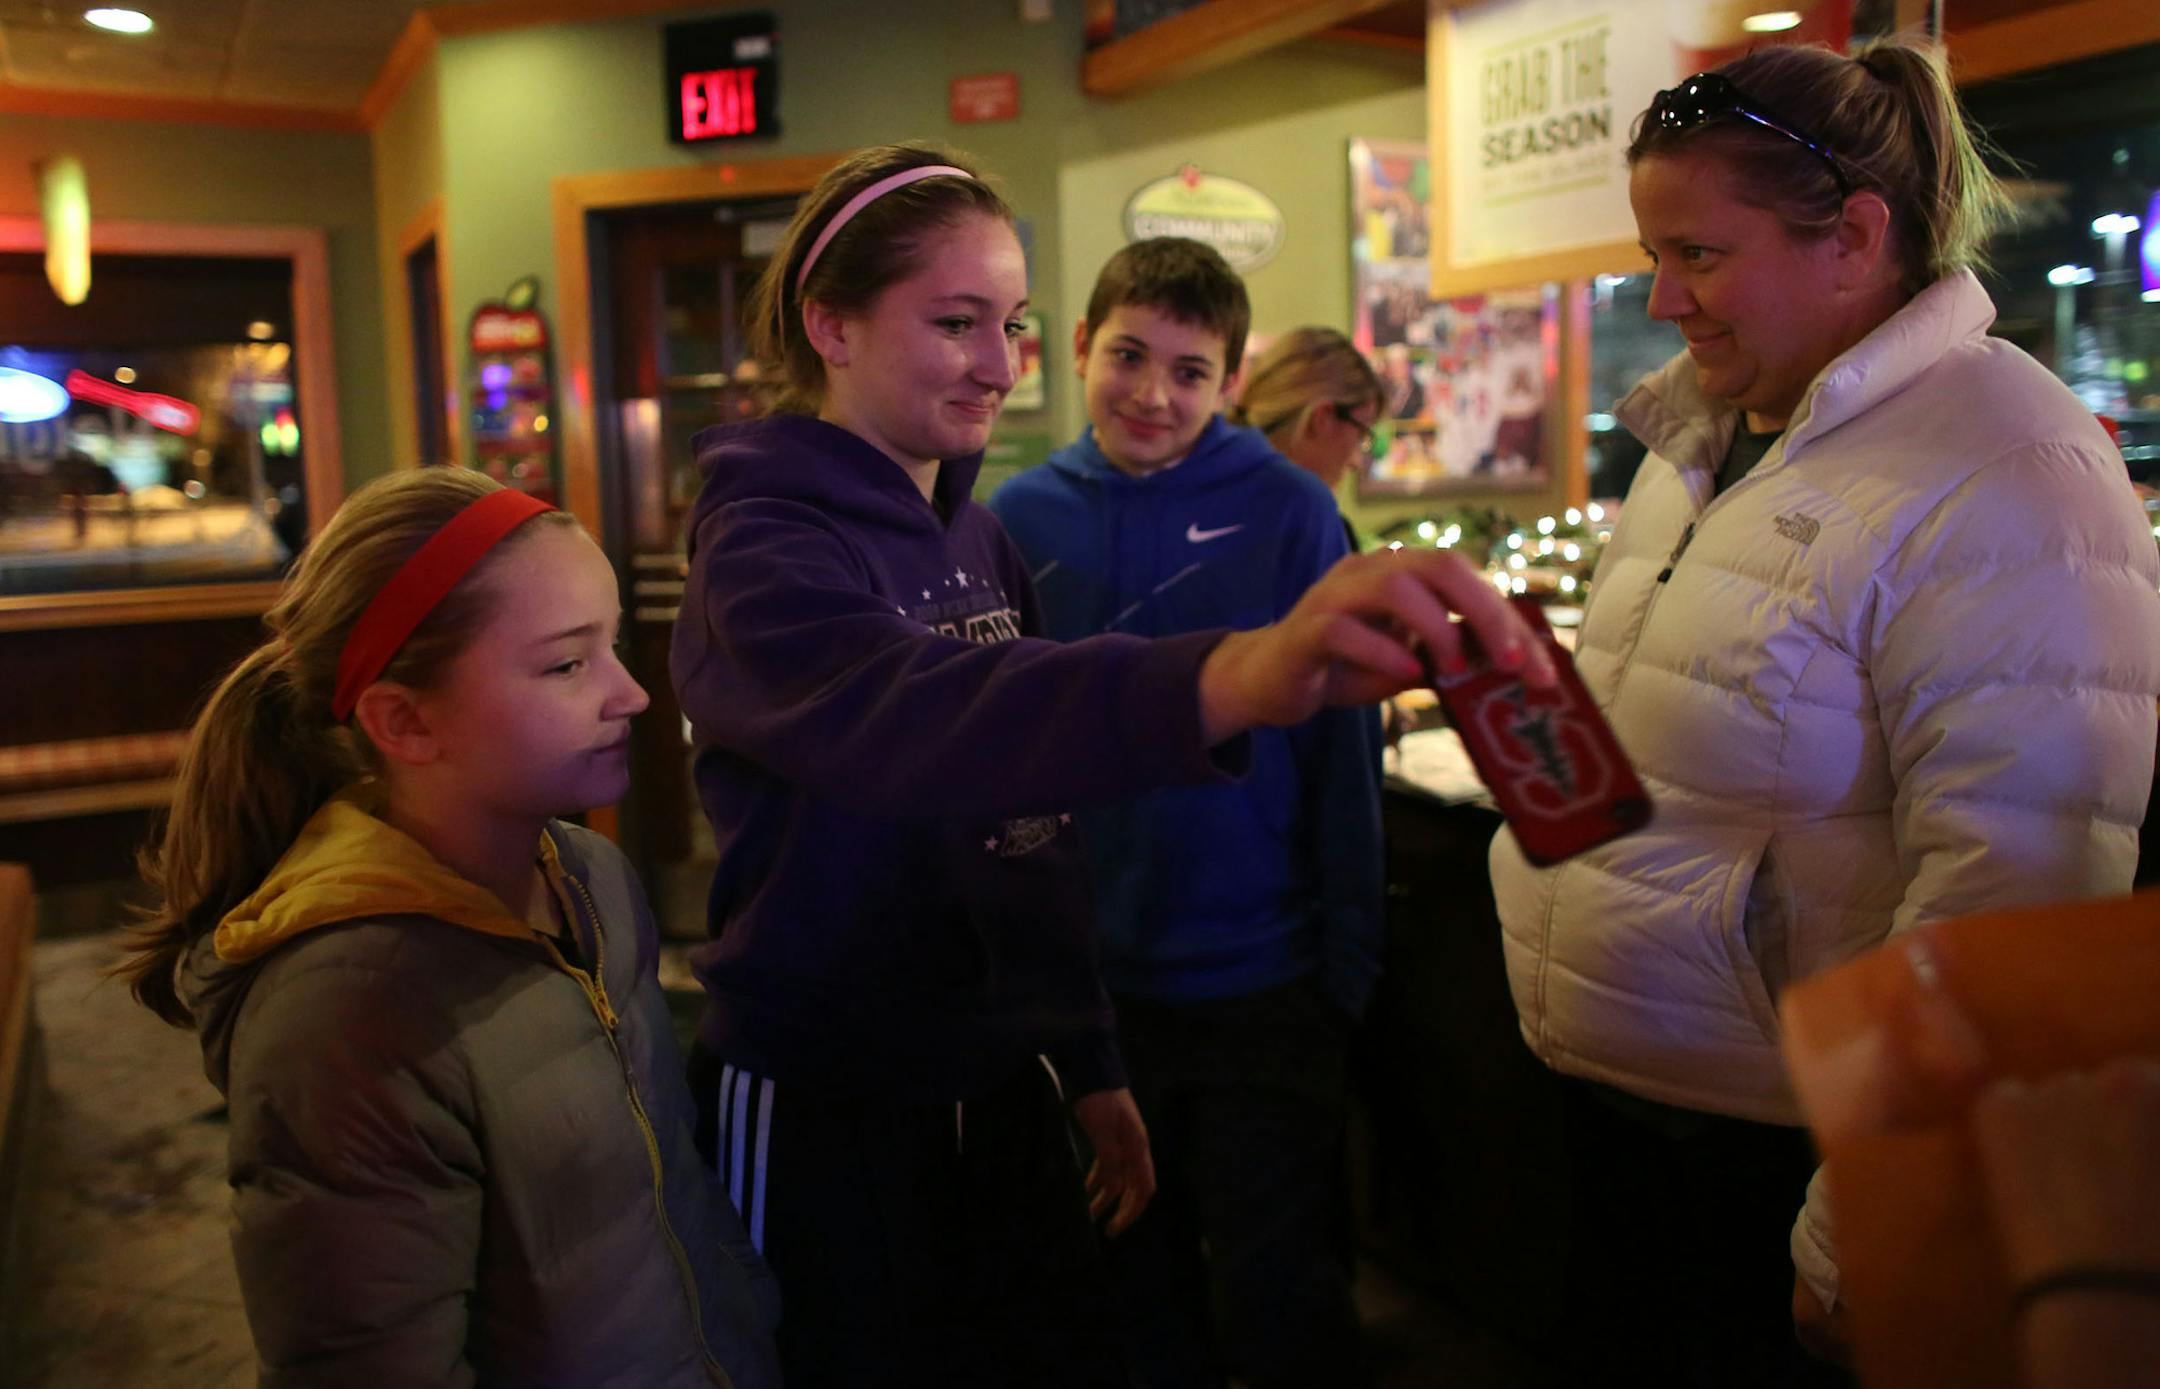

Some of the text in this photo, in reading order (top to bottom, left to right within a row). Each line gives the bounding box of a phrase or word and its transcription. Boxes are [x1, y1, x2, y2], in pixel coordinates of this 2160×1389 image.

[681, 67, 757, 140] EXIT
[1481, 26, 1611, 127] GRAB THE
[1481, 103, 1613, 168] SEASON
